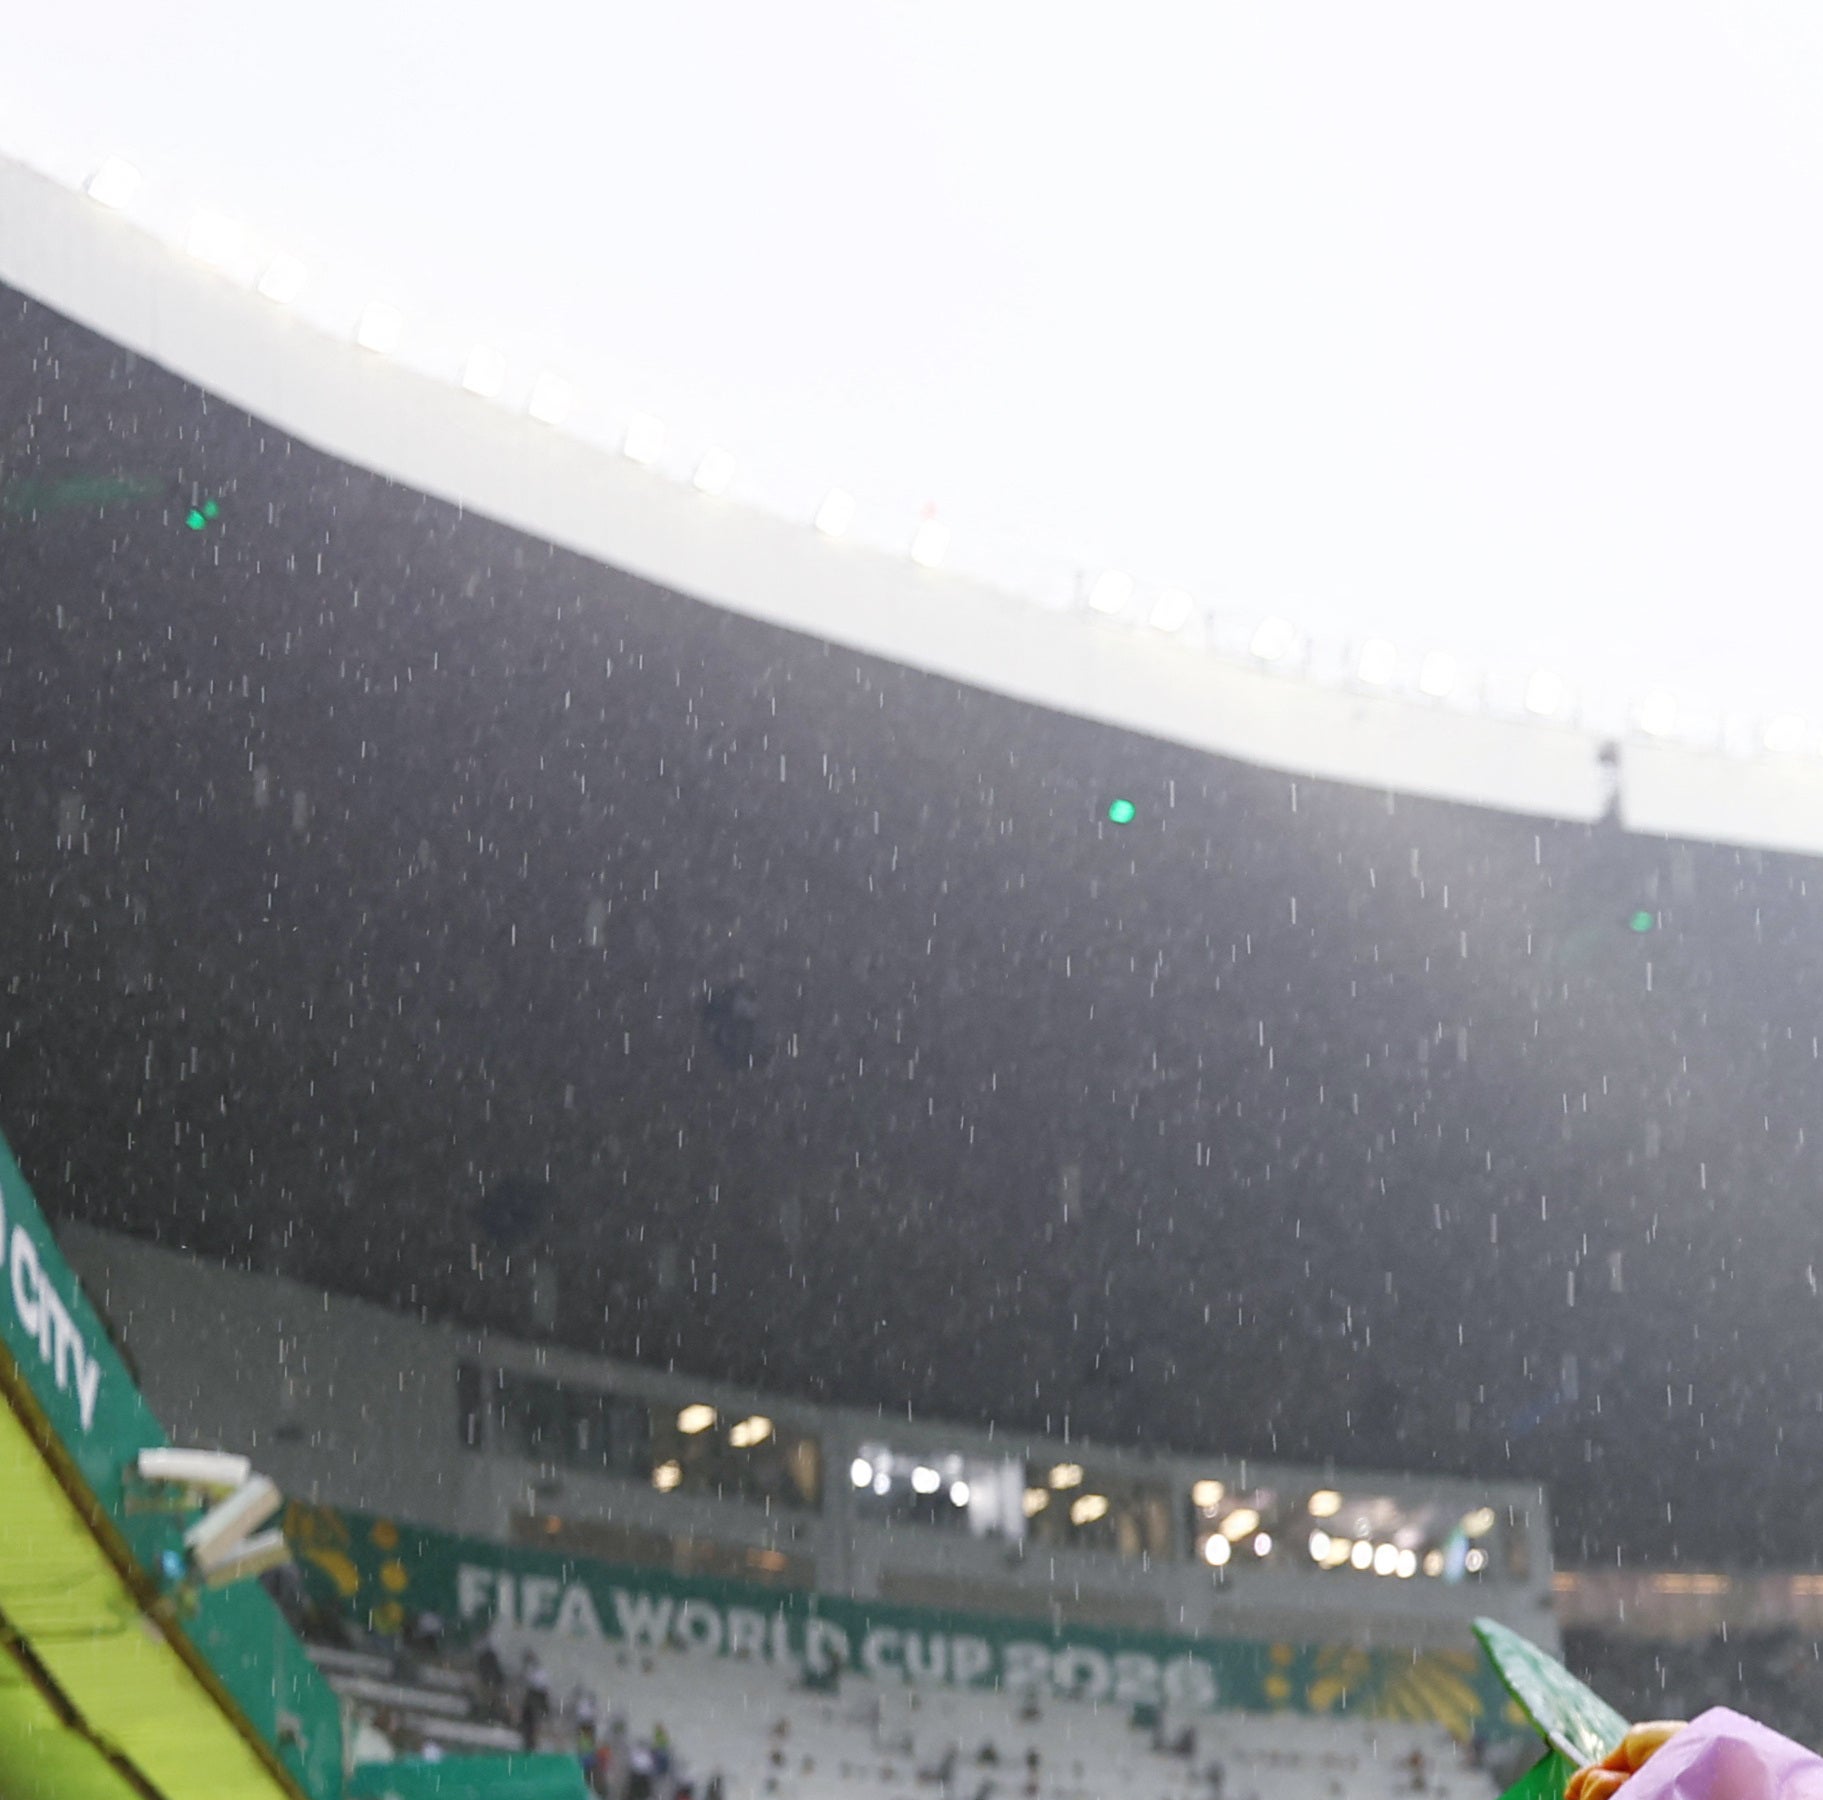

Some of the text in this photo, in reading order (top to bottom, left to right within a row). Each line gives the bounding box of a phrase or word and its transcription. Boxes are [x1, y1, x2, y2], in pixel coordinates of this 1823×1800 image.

[10, 1223, 100, 1432] CITY
[457, 1562, 603, 1636] FIFA
[610, 1586, 851, 1677] WORLD
[860, 1624, 992, 1687] CUP
